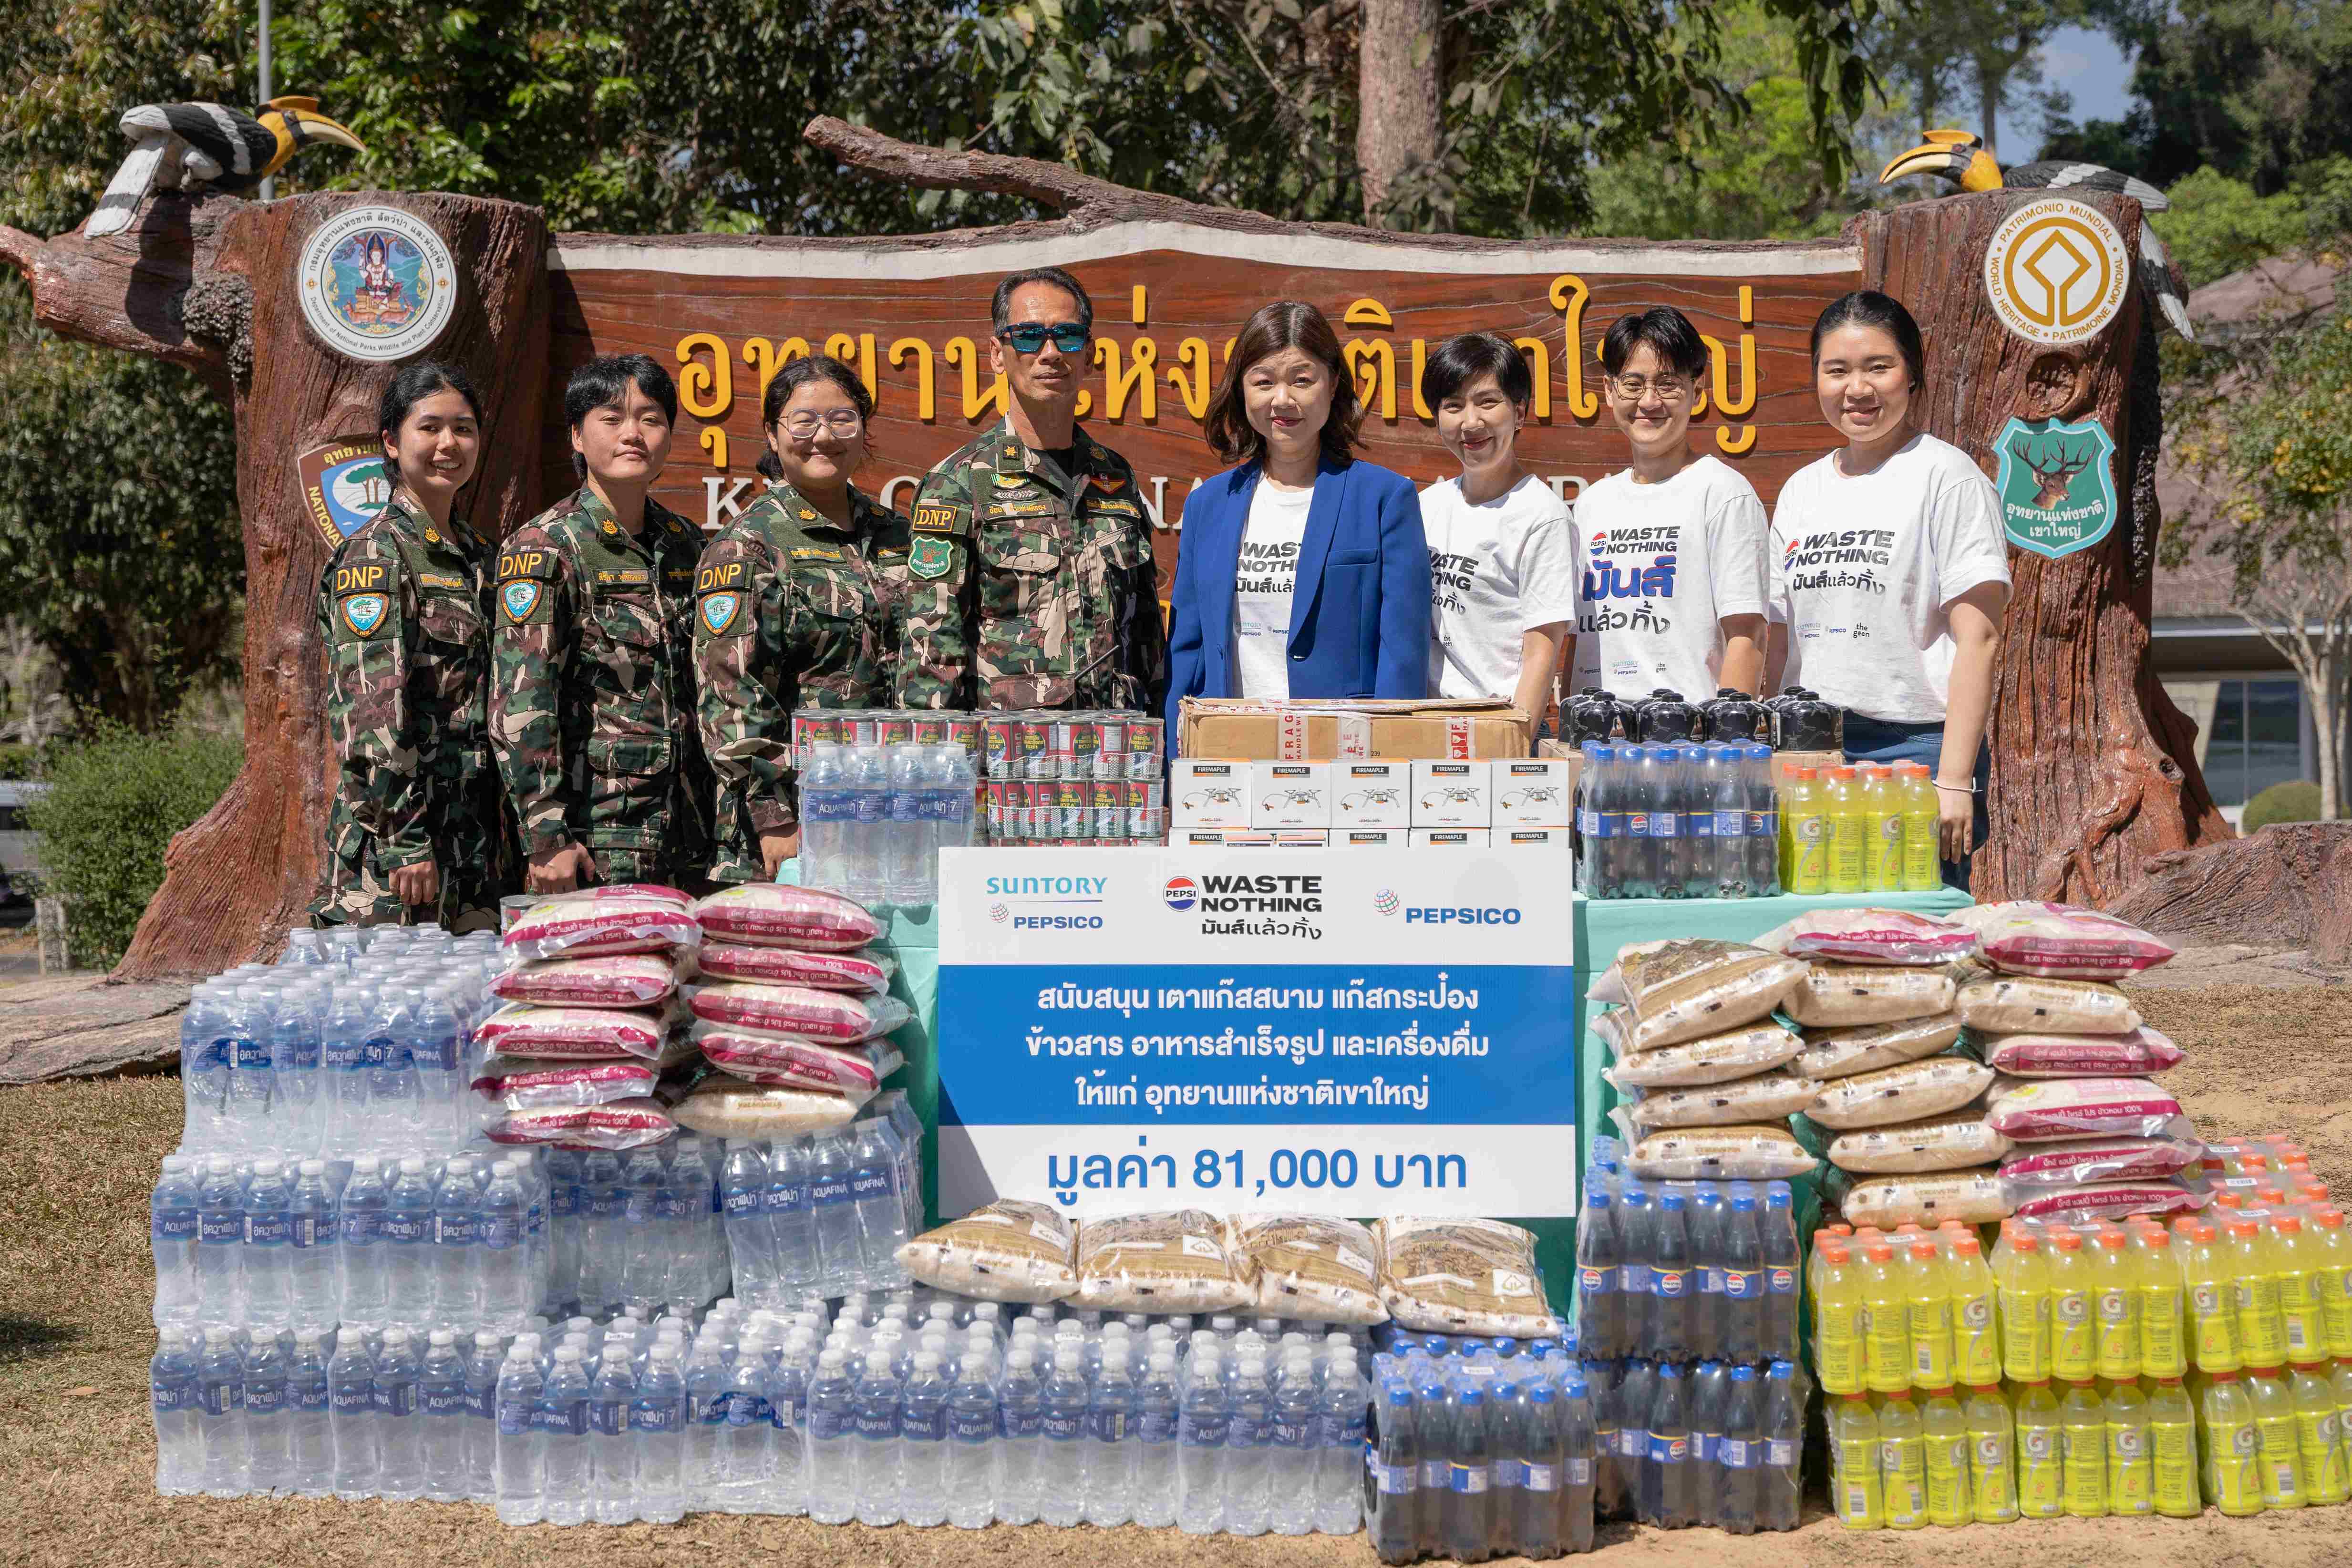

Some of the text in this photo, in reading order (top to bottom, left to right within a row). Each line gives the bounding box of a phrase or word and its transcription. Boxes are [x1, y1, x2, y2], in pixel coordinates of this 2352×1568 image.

[1999, 203, 2114, 242] PATRIMONIO MUNDIAL
[1990, 256, 2040, 337] WORLD HERITAGE
[2053, 257, 2124, 340] PATRIMOINE MONDIAL
[310, 297, 330, 328] Department
[335, 331, 358, 347] National
[401, 338, 412, 347] and
[412, 329, 426, 342] Plant
[916, 509, 951, 526] DNP
[2006, 499, 2104, 521] อุทยานแห่งชาติ
[1610, 526, 1681, 542] WASTE
[1804, 530, 1895, 550] WASTE
[2030, 522, 2081, 539] เขาใหญ่
[1243, 542, 1302, 558] WAS
[1606, 541, 1677, 554] NOTHING
[500, 553, 542, 577] DNP
[1237, 559, 1298, 573] NOTH
[1796, 549, 1889, 567] NOTHING
[336, 566, 383, 591] DNP
[699, 564, 742, 589] DNP
[1582, 555, 1677, 601] มันส์
[1853, 629, 1870, 638] geen
[1856, 622, 1868, 630] the
[1284, 714, 1294, 760] FRAG
[986, 877, 1108, 894] SUNTORY
[1165, 890, 1197, 898] PEPSI
[1201, 875, 1322, 894] WASTE
[1201, 897, 1322, 912] NOTHING
[1013, 916, 1103, 929] PEPSICO
[1406, 908, 1521, 925] PEPSICO
[1201, 917, 1322, 940] มันส์แล้วทิ้ง
[1037, 972, 1479, 1018] สนับสนุน เตาแก๊สสนาม แก๊สกระป๋อง
[1025, 1019, 1489, 1065] ข้าวสาร อาหารสำเร็จรูป และเครื่องดื่ม
[1075, 1069, 1429, 1114] ให้แก่ อุทยานแห่งชาติเขาใหญ่
[1048, 1135, 1467, 1206] มูลค่า 81,000 บาท
